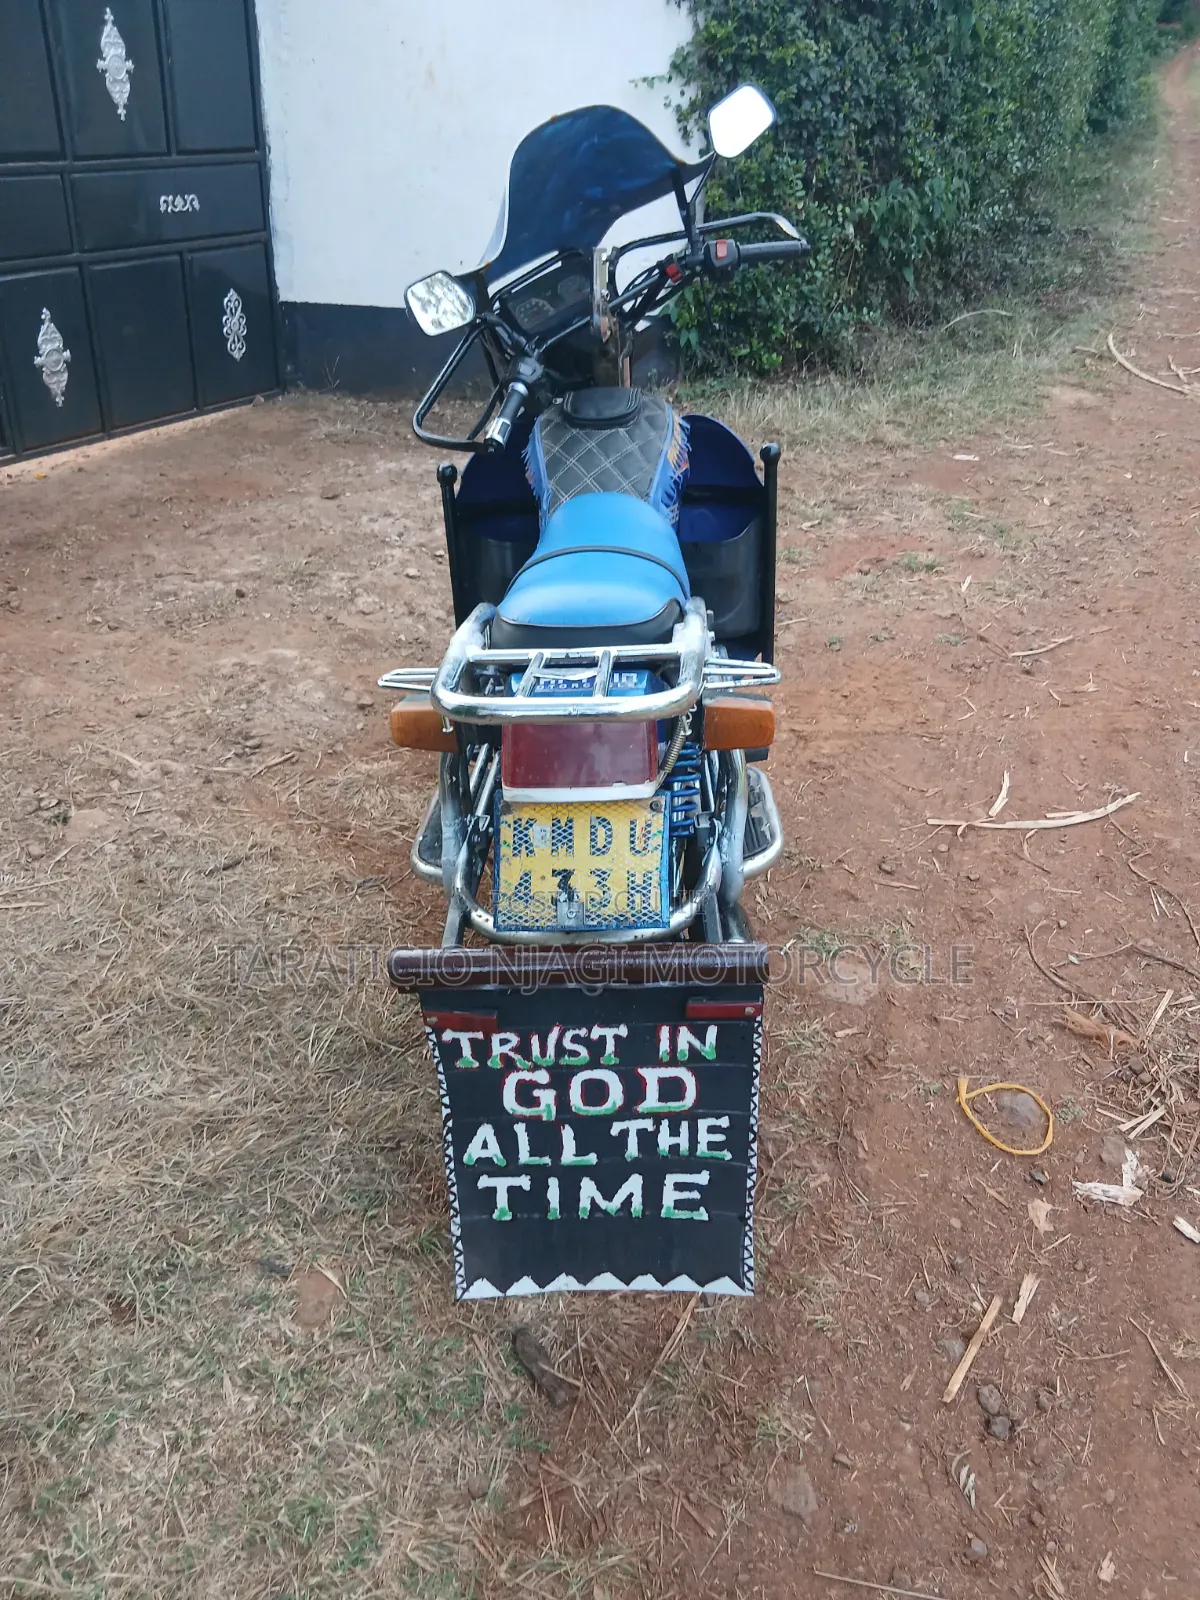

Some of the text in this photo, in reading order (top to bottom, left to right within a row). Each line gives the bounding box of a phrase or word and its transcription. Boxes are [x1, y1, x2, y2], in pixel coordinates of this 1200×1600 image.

[511, 816, 652, 857] KMDU
[441, 1023, 718, 1069] TRUST IN
[502, 1066, 698, 1121] GOD
[463, 1116, 733, 1167] ALL THE
[477, 1169, 710, 1221] TIME
